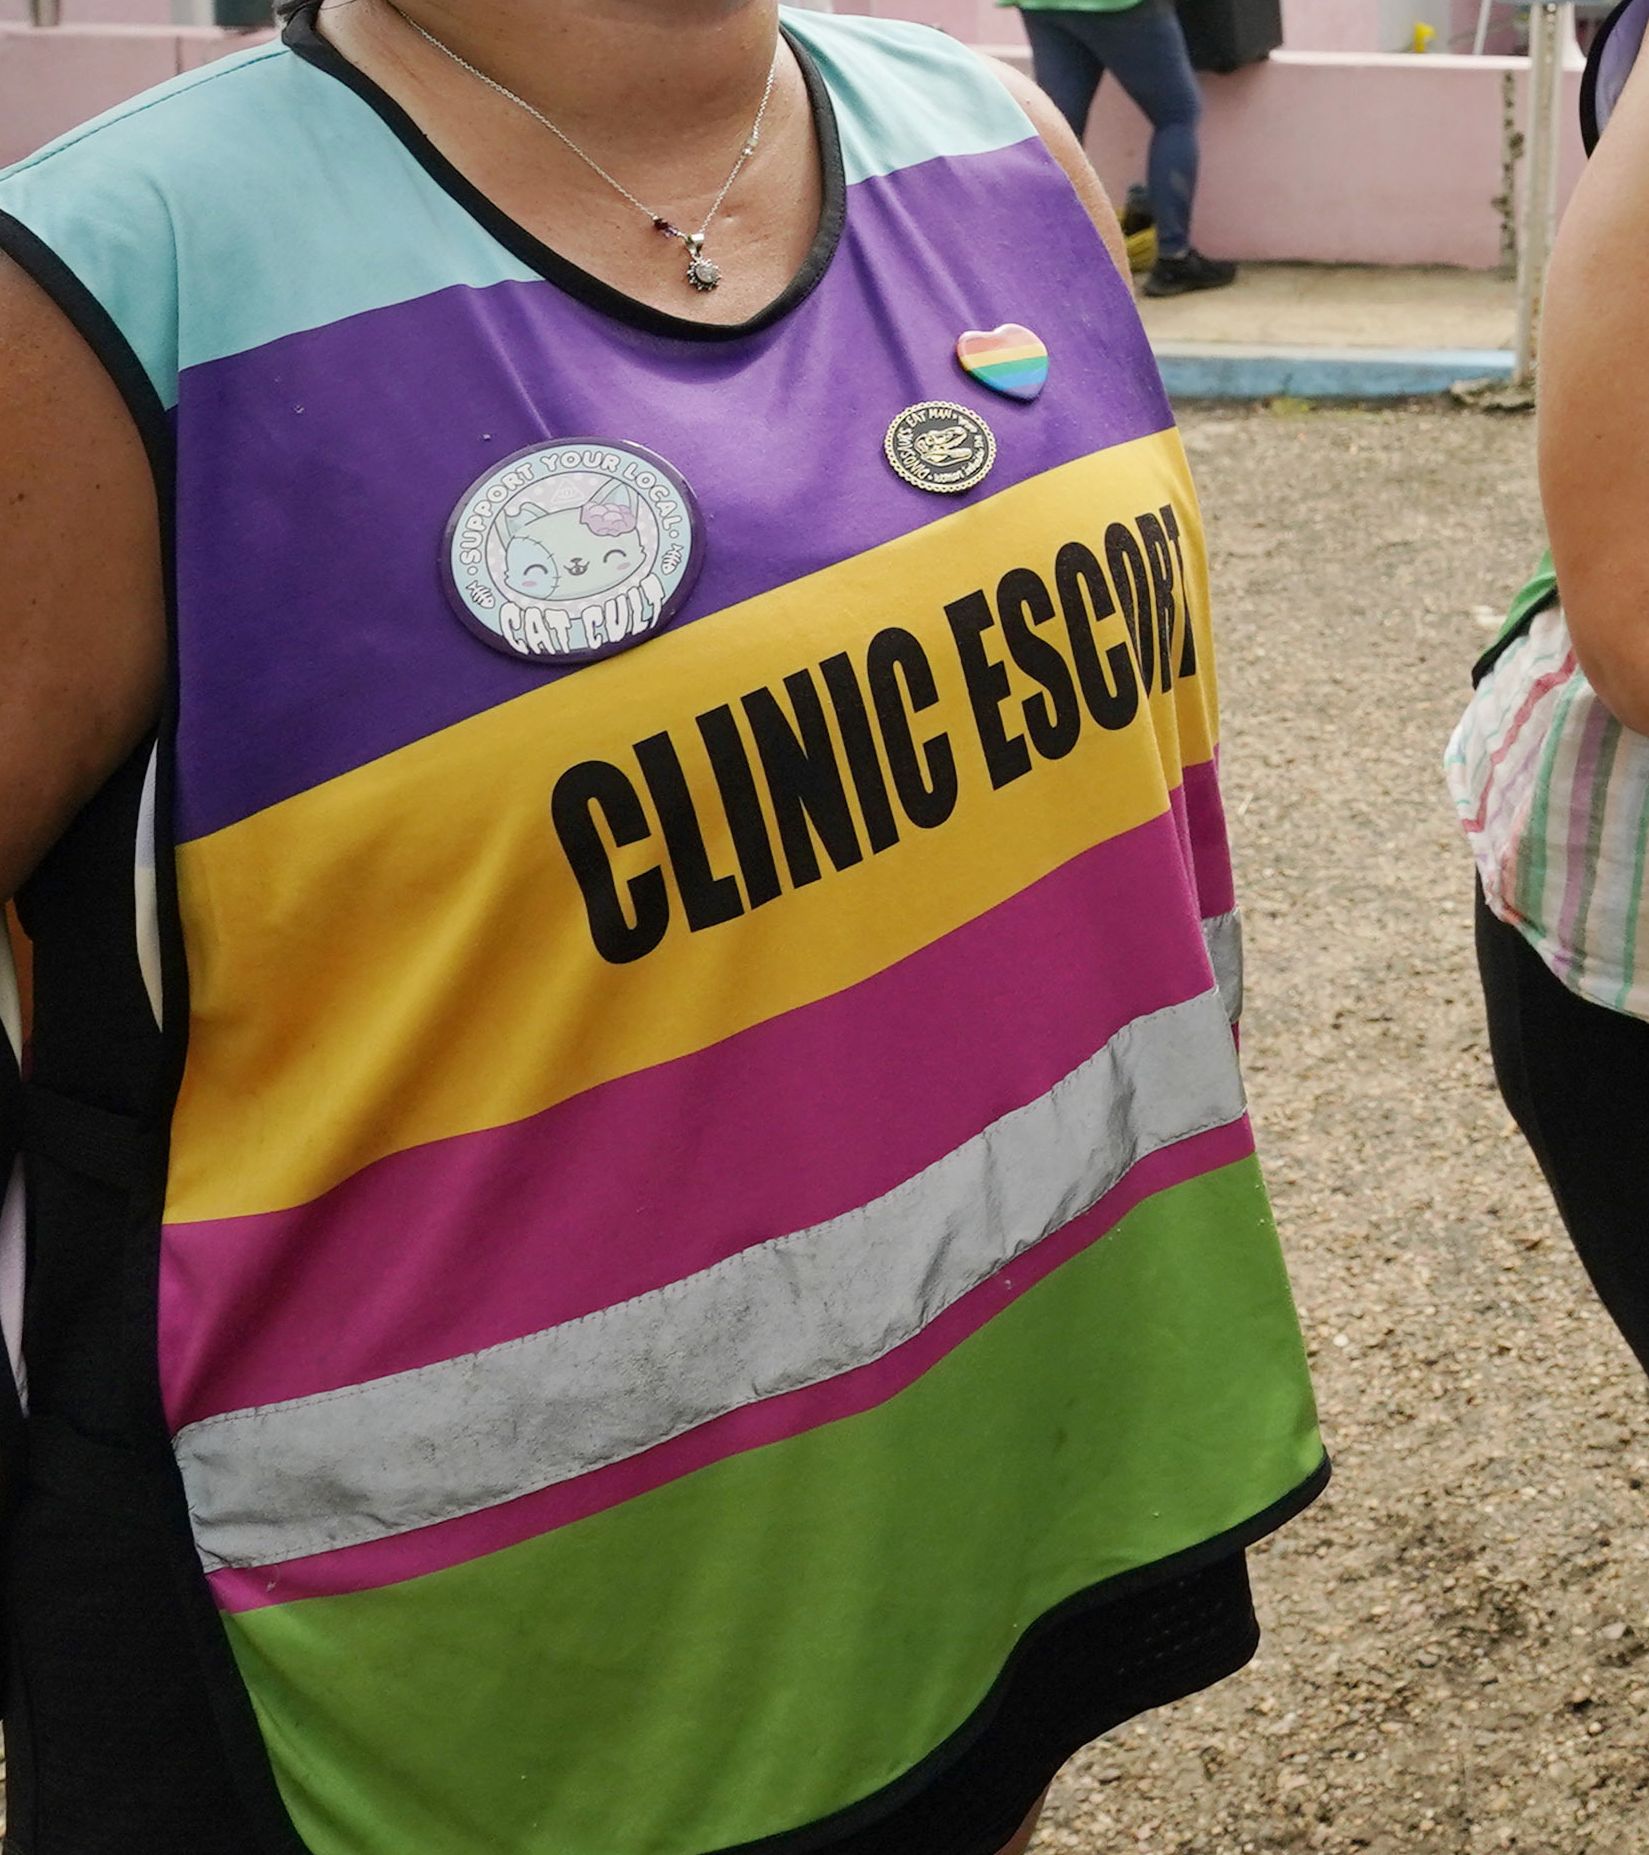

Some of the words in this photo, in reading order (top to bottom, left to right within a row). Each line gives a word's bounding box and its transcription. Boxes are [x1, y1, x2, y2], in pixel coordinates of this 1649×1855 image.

[905, 410, 926, 428] EAT
[928, 408, 952, 419] MAN
[460, 463, 533, 565] SUPPORT
[540, 450, 621, 472] YOUR
[623, 462, 683, 531] LOCAL
[501, 601, 573, 655] CAT
[581, 573, 666, 650] CULT
[551, 627, 959, 965] CLINIC
[944, 504, 1197, 791] ESCORT
